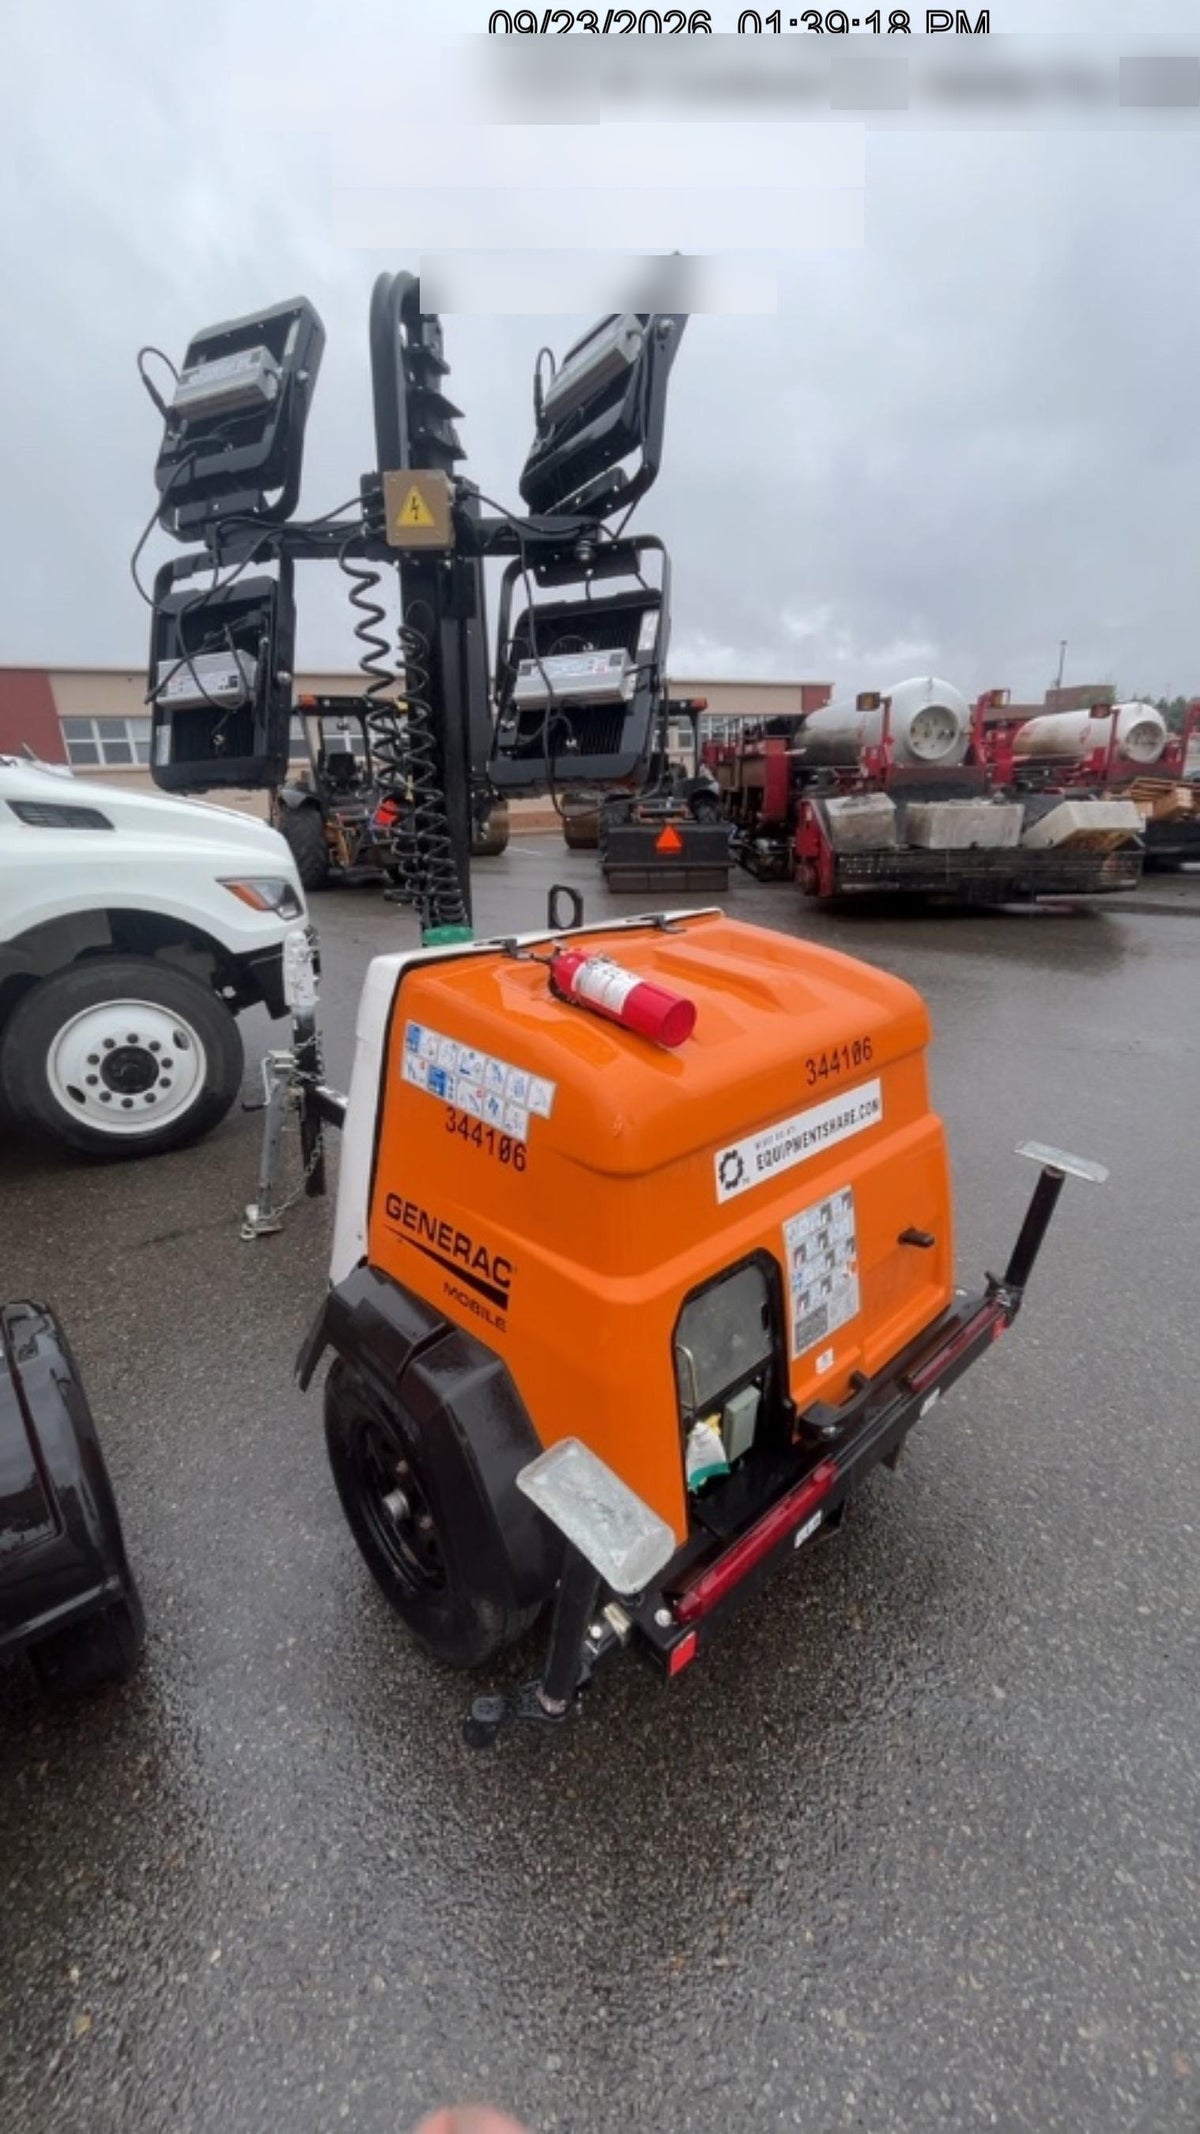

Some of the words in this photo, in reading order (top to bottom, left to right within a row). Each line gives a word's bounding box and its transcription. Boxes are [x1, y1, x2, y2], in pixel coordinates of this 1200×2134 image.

[805, 1036, 873, 1085] 344106
[445, 1107, 527, 1172] 344106
[756, 1097, 879, 1171] EQUIPMENTSHARE.COM
[385, 1192, 513, 1289] GENERAC
[443, 1282, 507, 1333] MOBILE
